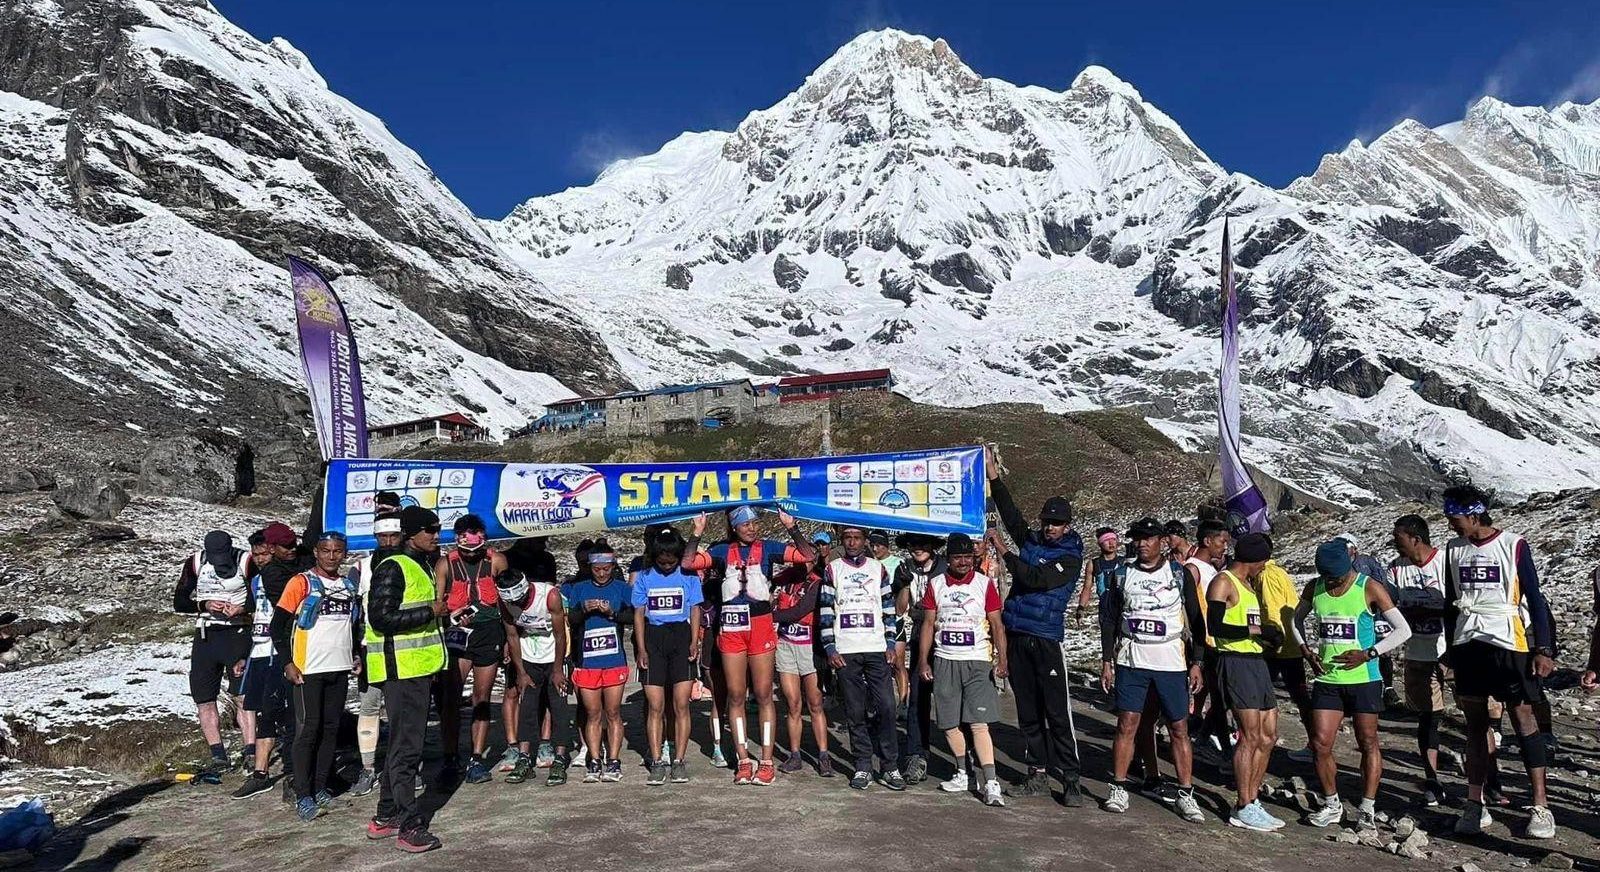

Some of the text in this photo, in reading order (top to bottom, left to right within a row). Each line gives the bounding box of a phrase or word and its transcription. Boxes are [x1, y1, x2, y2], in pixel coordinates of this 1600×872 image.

[619, 466, 801, 507] START
[503, 507, 573, 524] MARATHON
[657, 596, 673, 608] 09
[725, 613, 739, 624] 03
[849, 614, 865, 626] 54
[1137, 620, 1155, 632] 49
[1327, 624, 1343, 636] 34
[591, 636, 607, 649] 02
[949, 632, 965, 644] 53
